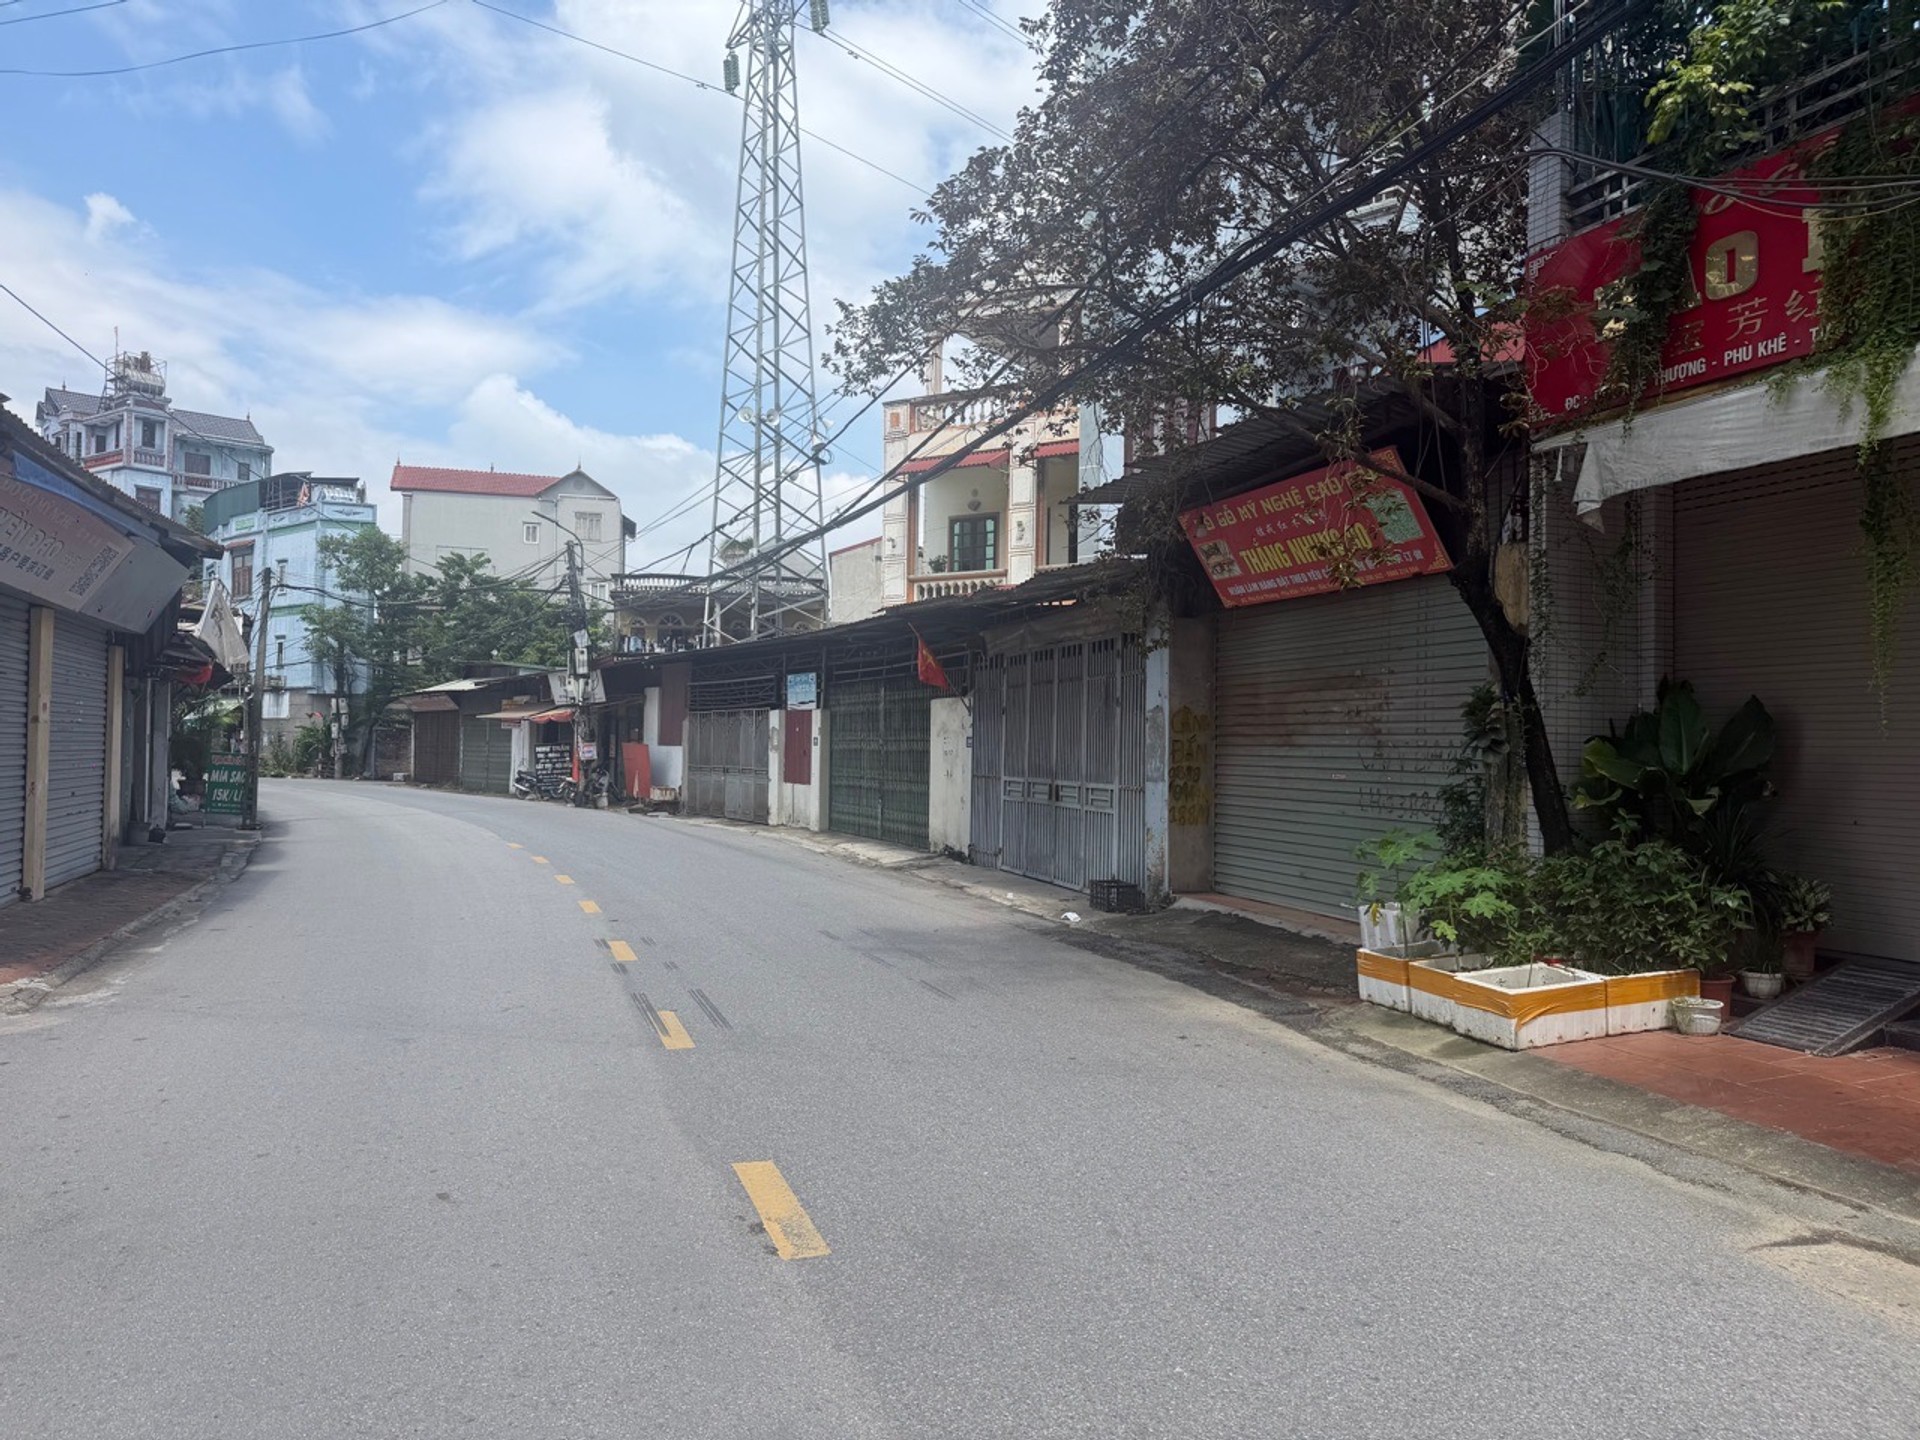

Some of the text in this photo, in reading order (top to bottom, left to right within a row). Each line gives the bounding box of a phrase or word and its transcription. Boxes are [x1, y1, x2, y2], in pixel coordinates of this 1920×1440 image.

[1724, 341, 1752, 367] PHÙ
[1758, 332, 1787, 359] KHÊ
[230, 770, 248, 786] SẠC
